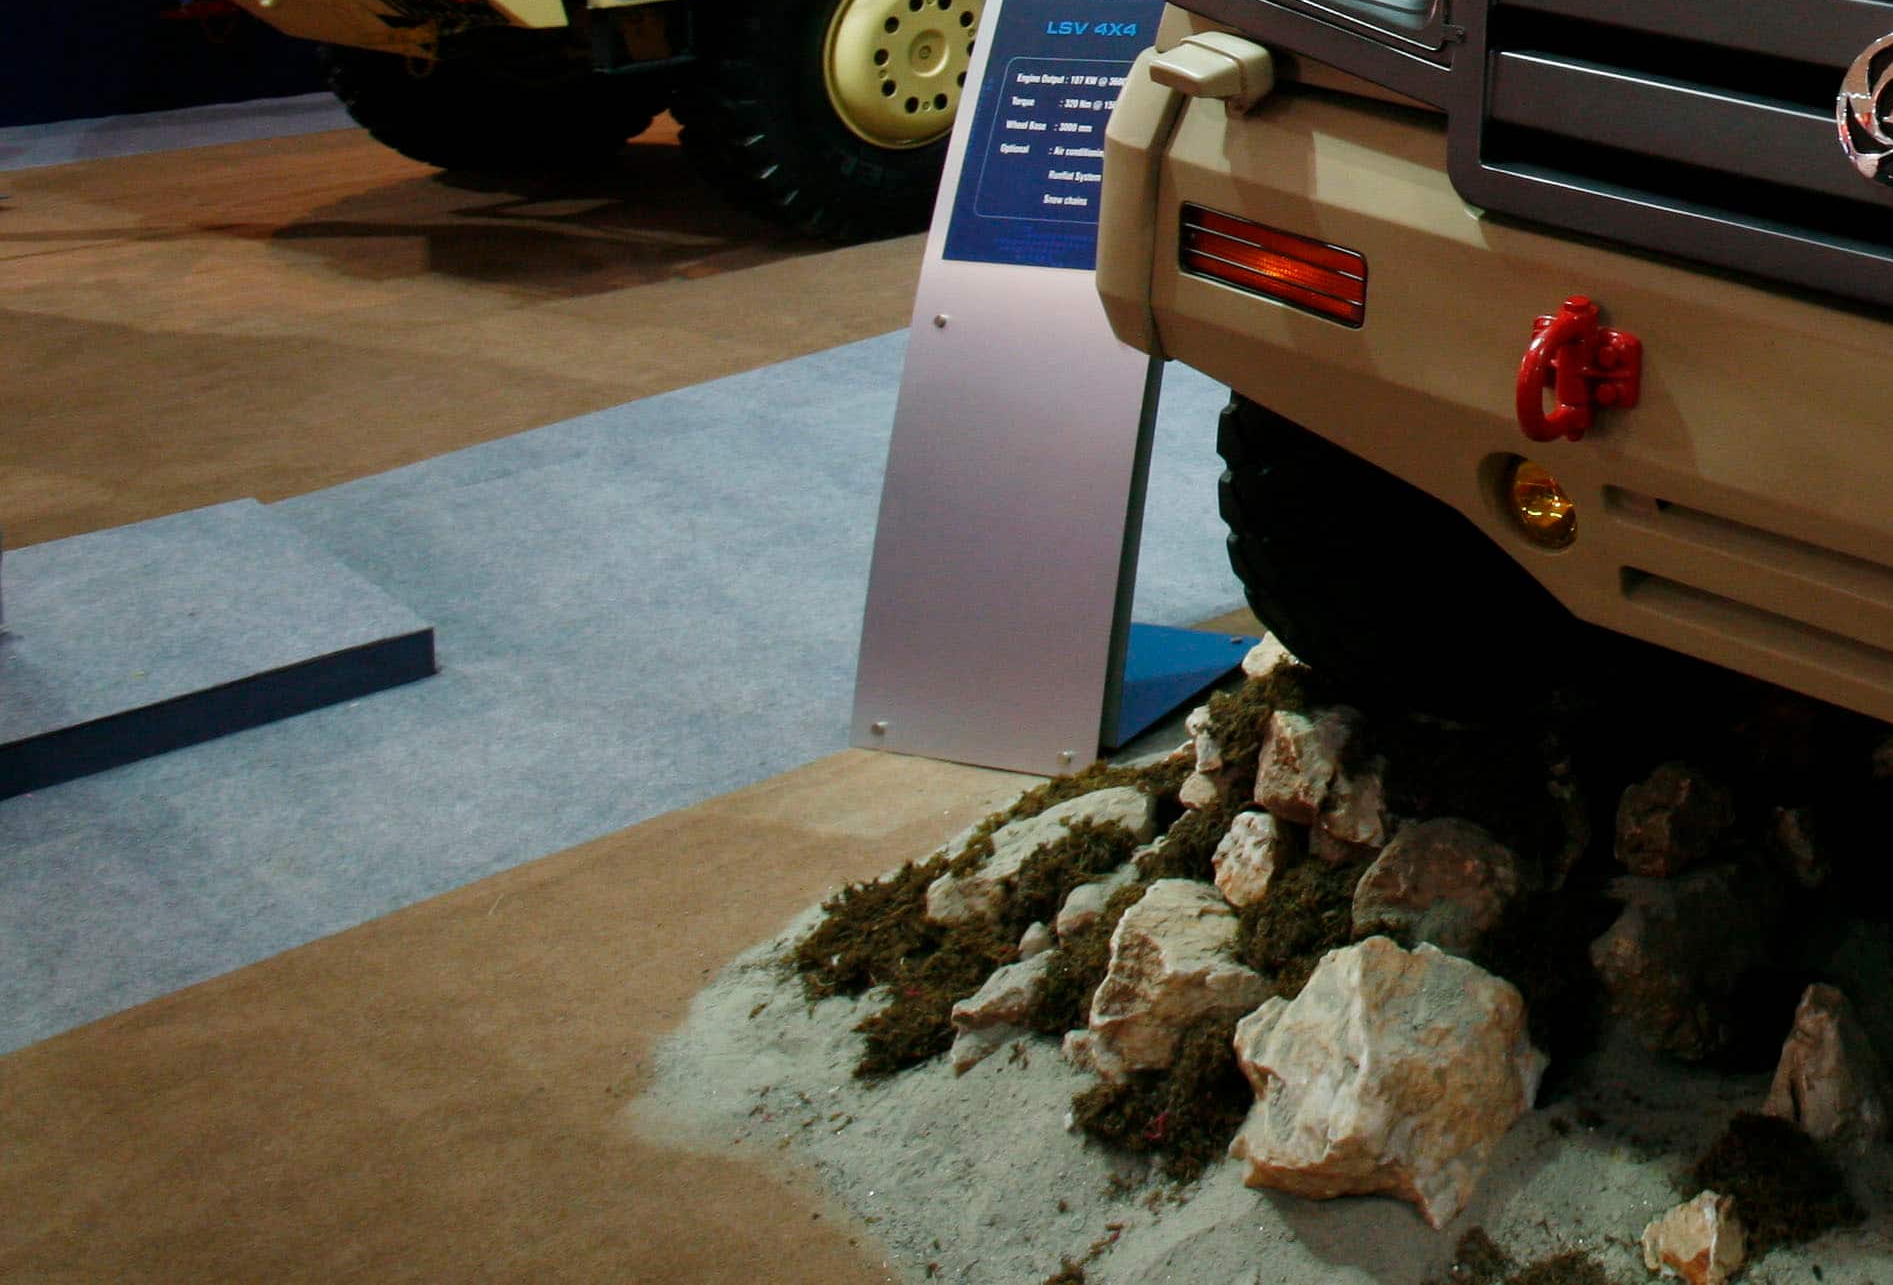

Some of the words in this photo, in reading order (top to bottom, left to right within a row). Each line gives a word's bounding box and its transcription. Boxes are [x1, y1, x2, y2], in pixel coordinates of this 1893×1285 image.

[1047, 21, 1089, 35] LSV
[1094, 22, 1137, 37] 4X4
[1016, 73, 1040, 85] Engine
[1041, 74, 1065, 86] Output
[1012, 96, 1035, 107] Torque
[1006, 119, 1028, 130] Wheel
[1029, 120, 1047, 131] Base
[1000, 143, 1030, 154] Optional
[1053, 146, 1065, 156] Air
[1075, 171, 1102, 184] System
[1043, 194, 1063, 205] Snow
[1064, 195, 1088, 206] chains
